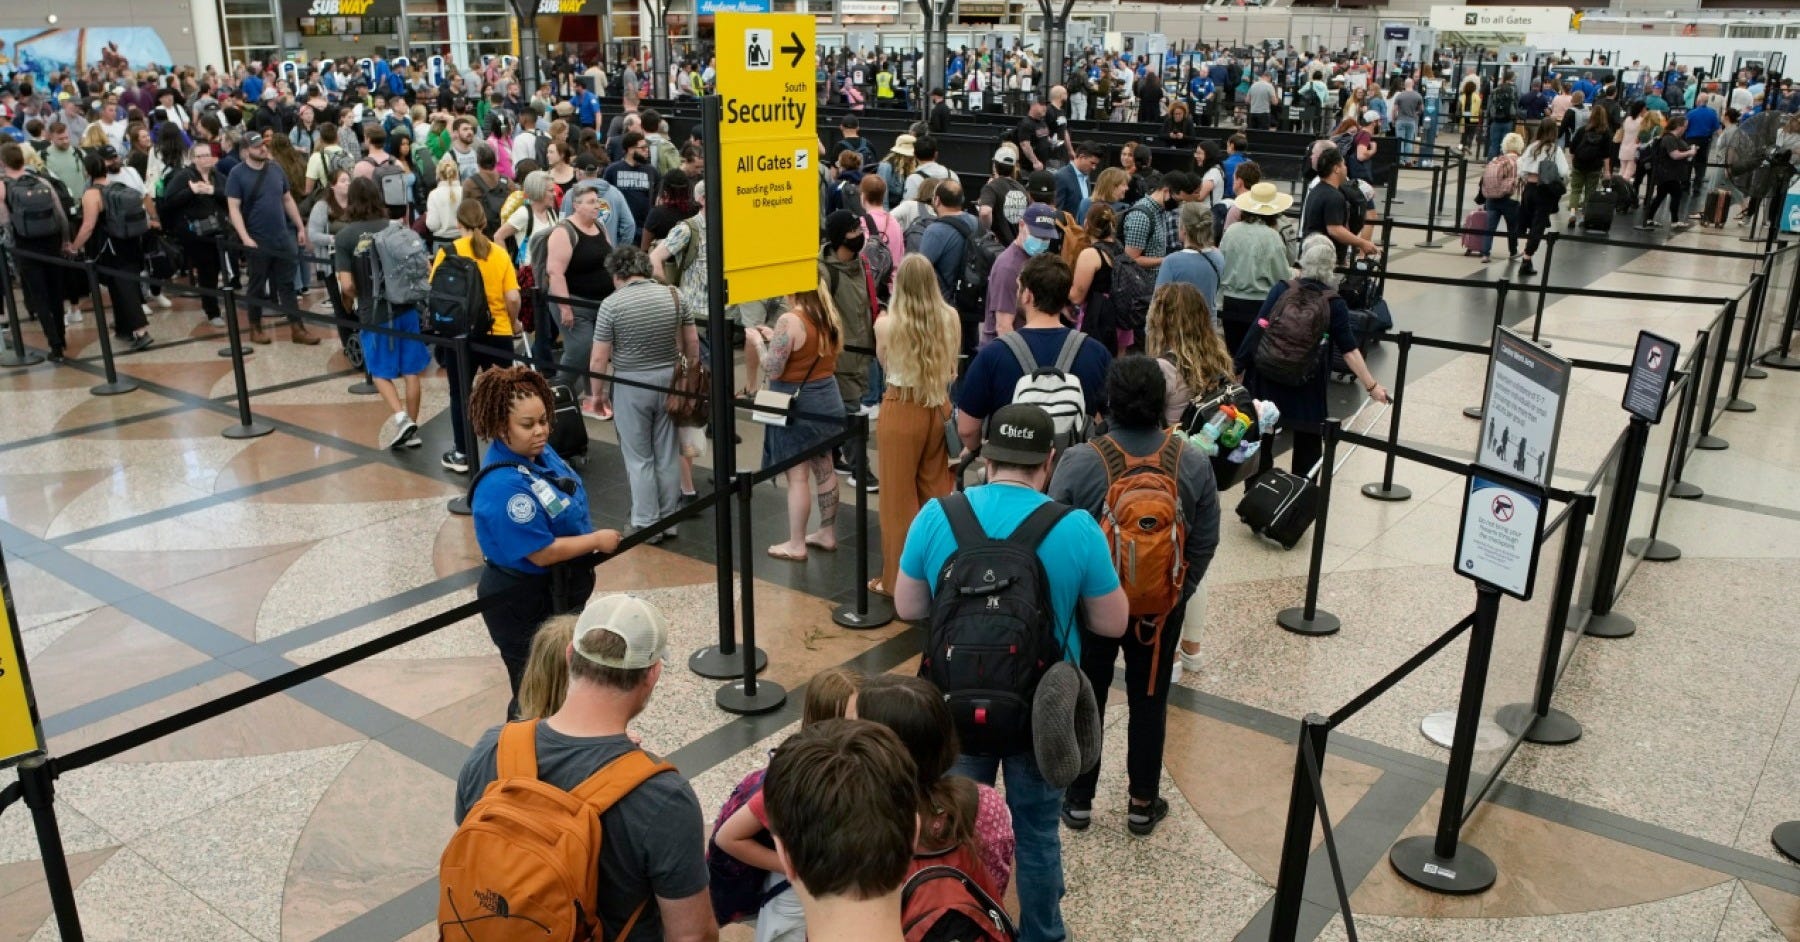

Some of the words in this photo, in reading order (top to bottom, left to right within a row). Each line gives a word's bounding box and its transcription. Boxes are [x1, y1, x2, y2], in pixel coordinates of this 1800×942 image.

[308, 0, 375, 15] SUBWAY
[537, 0, 588, 13] SUBWAY
[1481, 16, 1490, 24] to
[1492, 16, 1503, 24] all
[1506, 16, 1532, 24] Gates
[784, 82, 806, 92] South
[727, 96, 806, 129] Security
[737, 156, 754, 173] All
[756, 155, 792, 171] Gates
[737, 184, 768, 196] Boarding
[770, 183, 784, 192] Pass
[786, 181, 792, 190] &
[753, 199, 760, 208] ID
[762, 196, 793, 207] Required
[1000, 424, 1034, 439] Chiefs
